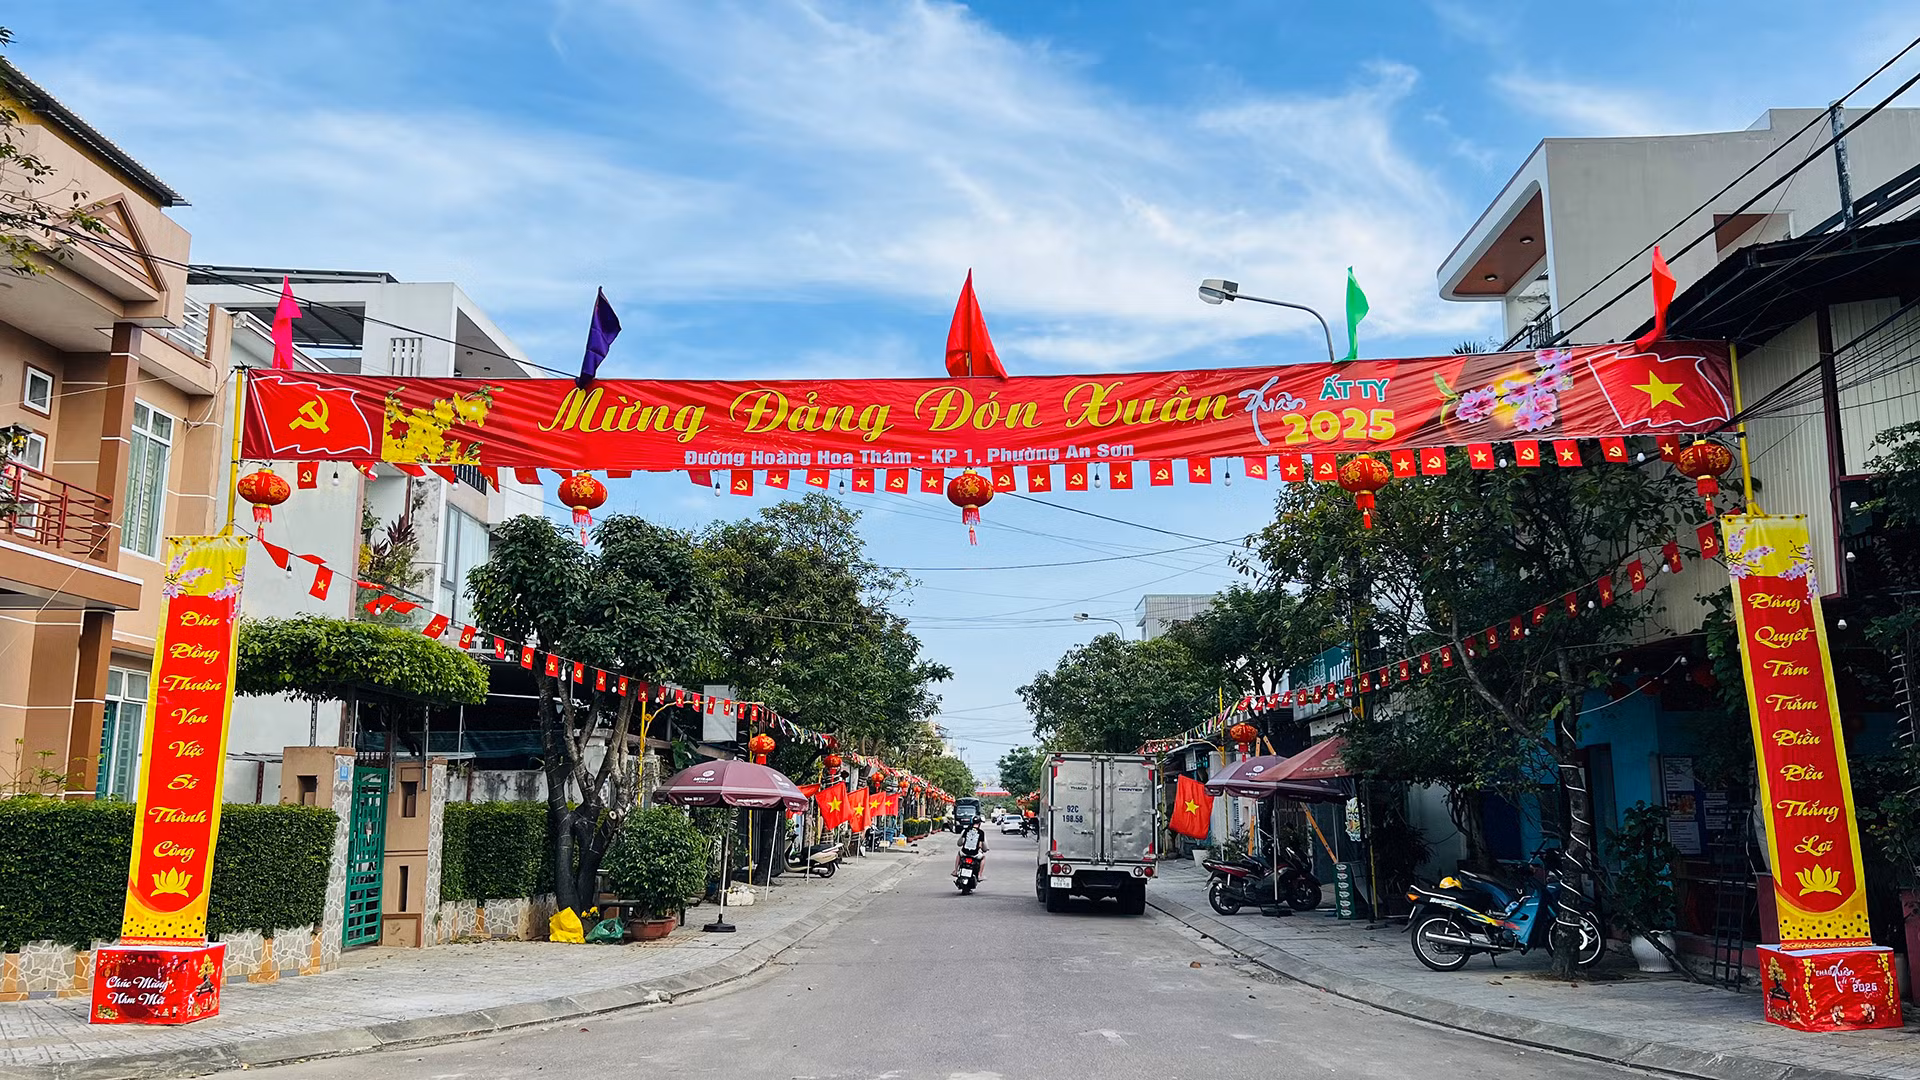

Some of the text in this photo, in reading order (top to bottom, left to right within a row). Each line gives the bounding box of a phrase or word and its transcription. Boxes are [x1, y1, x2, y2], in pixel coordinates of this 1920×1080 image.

[1319, 374, 1354, 400] ẤT
[537, 381, 1235, 443] Mừng Đảng Đón Xuân
[1282, 408, 1396, 445] 2025
[684, 450, 745, 466] Đường
[751, 450, 811, 466] Hoàng
[817, 450, 854, 465] Hoa
[859, 449, 912, 465] Thám
[931, 449, 957, 464] KP
[963, 449, 981, 465] 1,
[987, 447, 1060, 463] Phường
[1065, 445, 1091, 459] An
[1096, 444, 1134, 457] Sơn
[1747, 593, 1801, 614] Đảng
[1754, 625, 1816, 649] Quyết
[169, 642, 220, 665] Đồng
[1763, 660, 1810, 677] Tâm
[162, 674, 222, 692] Thuận
[1765, 694, 1819, 712] Trăm
[171, 707, 208, 725] Vạn
[1772, 728, 1821, 746] Điều
[168, 740, 204, 758] Việc
[167, 773, 200, 790] Sẽ
[1780, 764, 1825, 782] Đều
[148, 806, 207, 823] Thành
[1066, 805, 1080, 814] 92C
[1776, 799, 1840, 823] Thắng
[1062, 815, 1084, 824] 198.58
[153, 840, 196, 863] Công
[1794, 834, 1834, 856] Lợi
[106, 975, 168, 994] Chúc Mừng
[107, 991, 136, 1005] Năm
